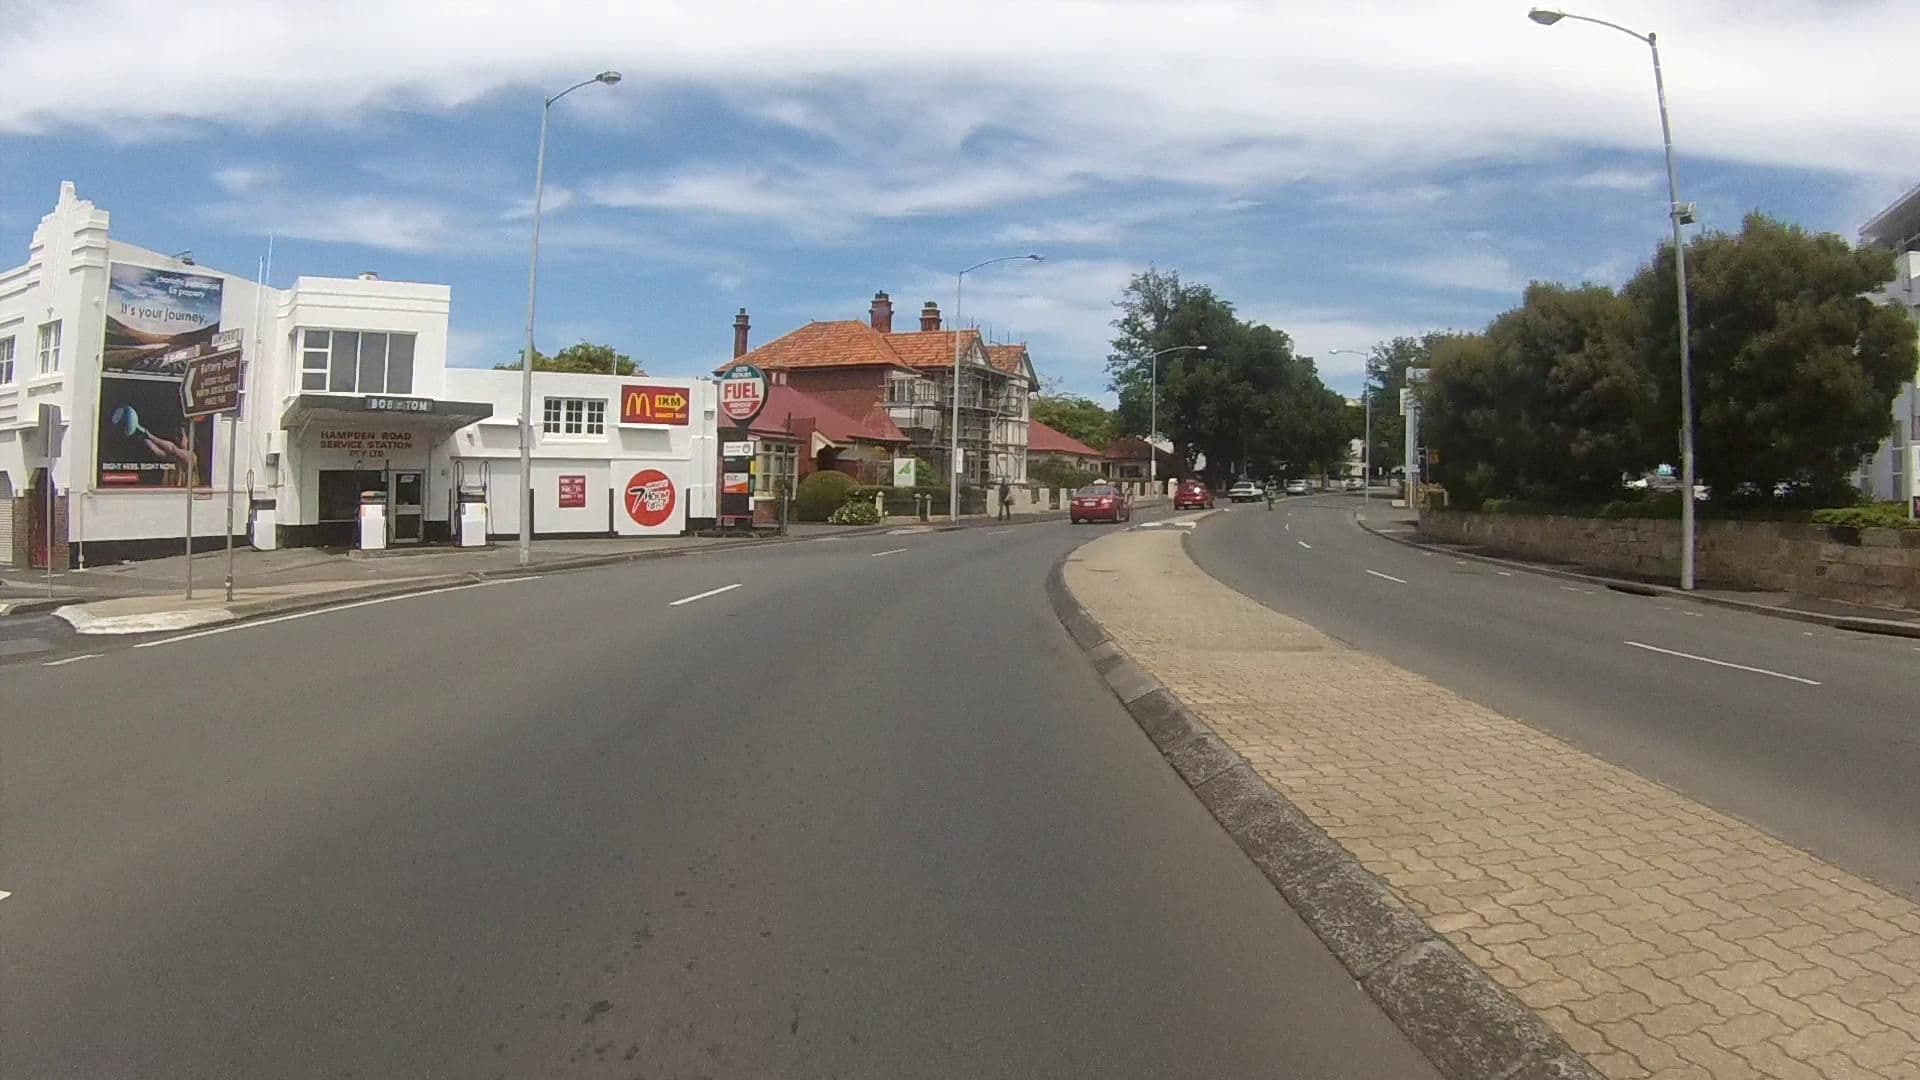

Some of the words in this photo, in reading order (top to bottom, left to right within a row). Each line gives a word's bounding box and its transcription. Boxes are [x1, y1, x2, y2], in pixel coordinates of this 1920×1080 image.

[139, 308, 162, 319] your
[724, 382, 760, 399] FUEL
[405, 400, 428, 411] TOM
[320, 431, 376, 440] HAMPDEN
[382, 432, 412, 441] ROAD
[320, 440, 362, 449] SERVICE
[368, 441, 412, 449] STATION
[349, 450, 368, 458] PTY
[370, 450, 384, 458] LTD
